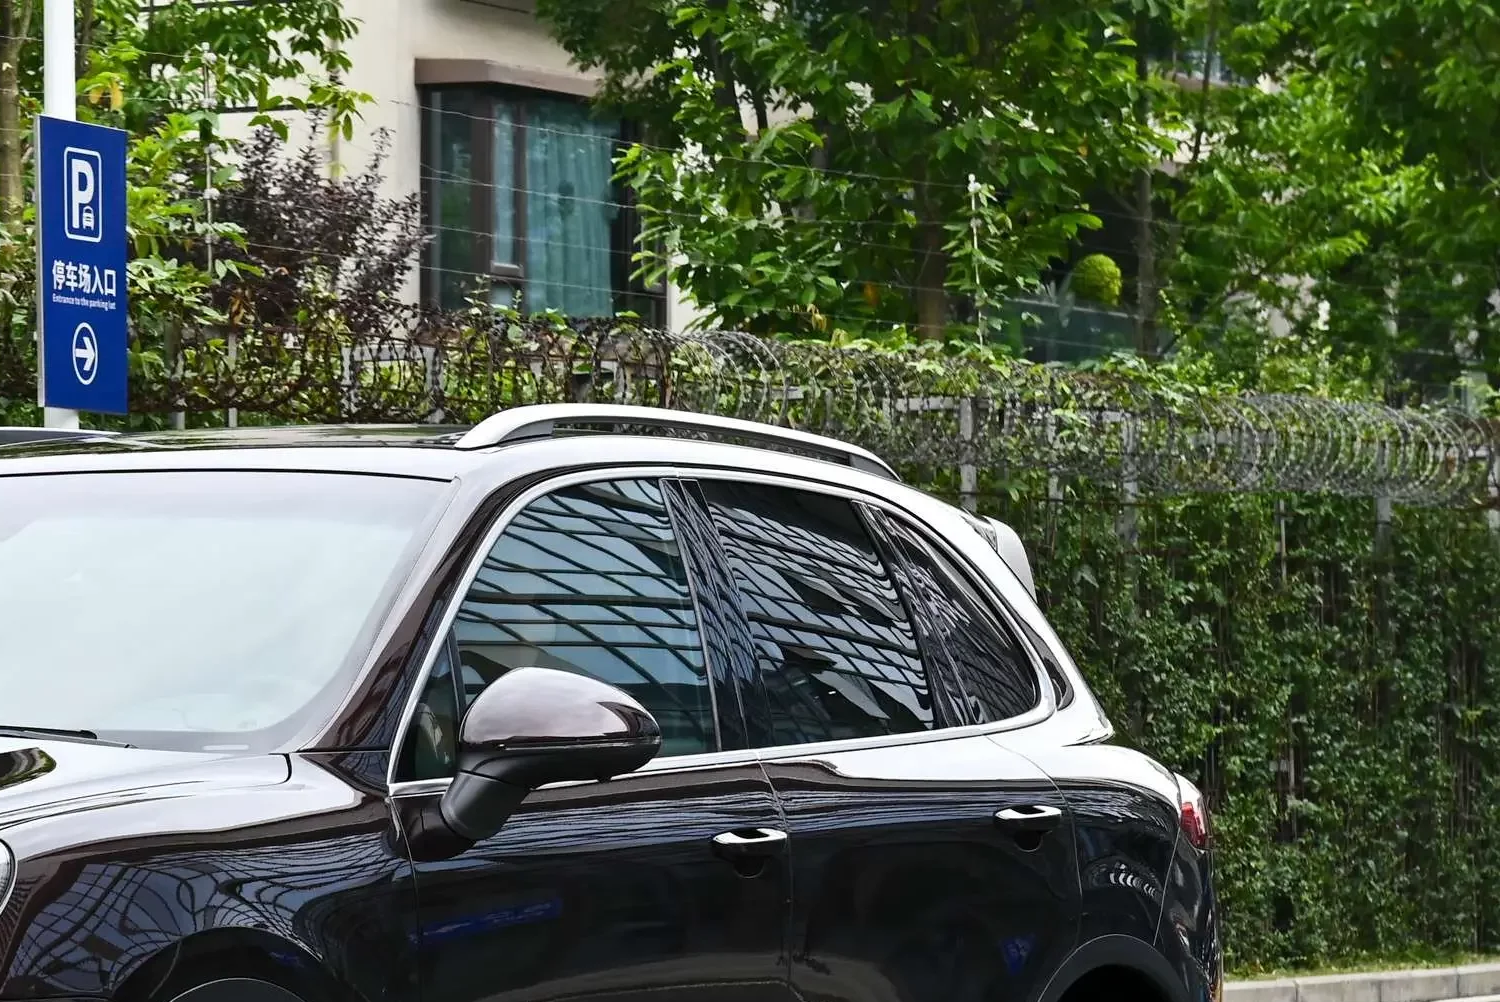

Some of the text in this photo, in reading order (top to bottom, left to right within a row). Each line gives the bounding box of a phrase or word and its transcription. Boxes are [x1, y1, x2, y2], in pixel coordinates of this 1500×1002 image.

[52, 259, 116, 297] 停车场入口
[52, 293, 74, 305] Entrance
[74, 297, 80, 306] to
[80, 297, 89, 307] the
[89, 299, 108, 311] parking
